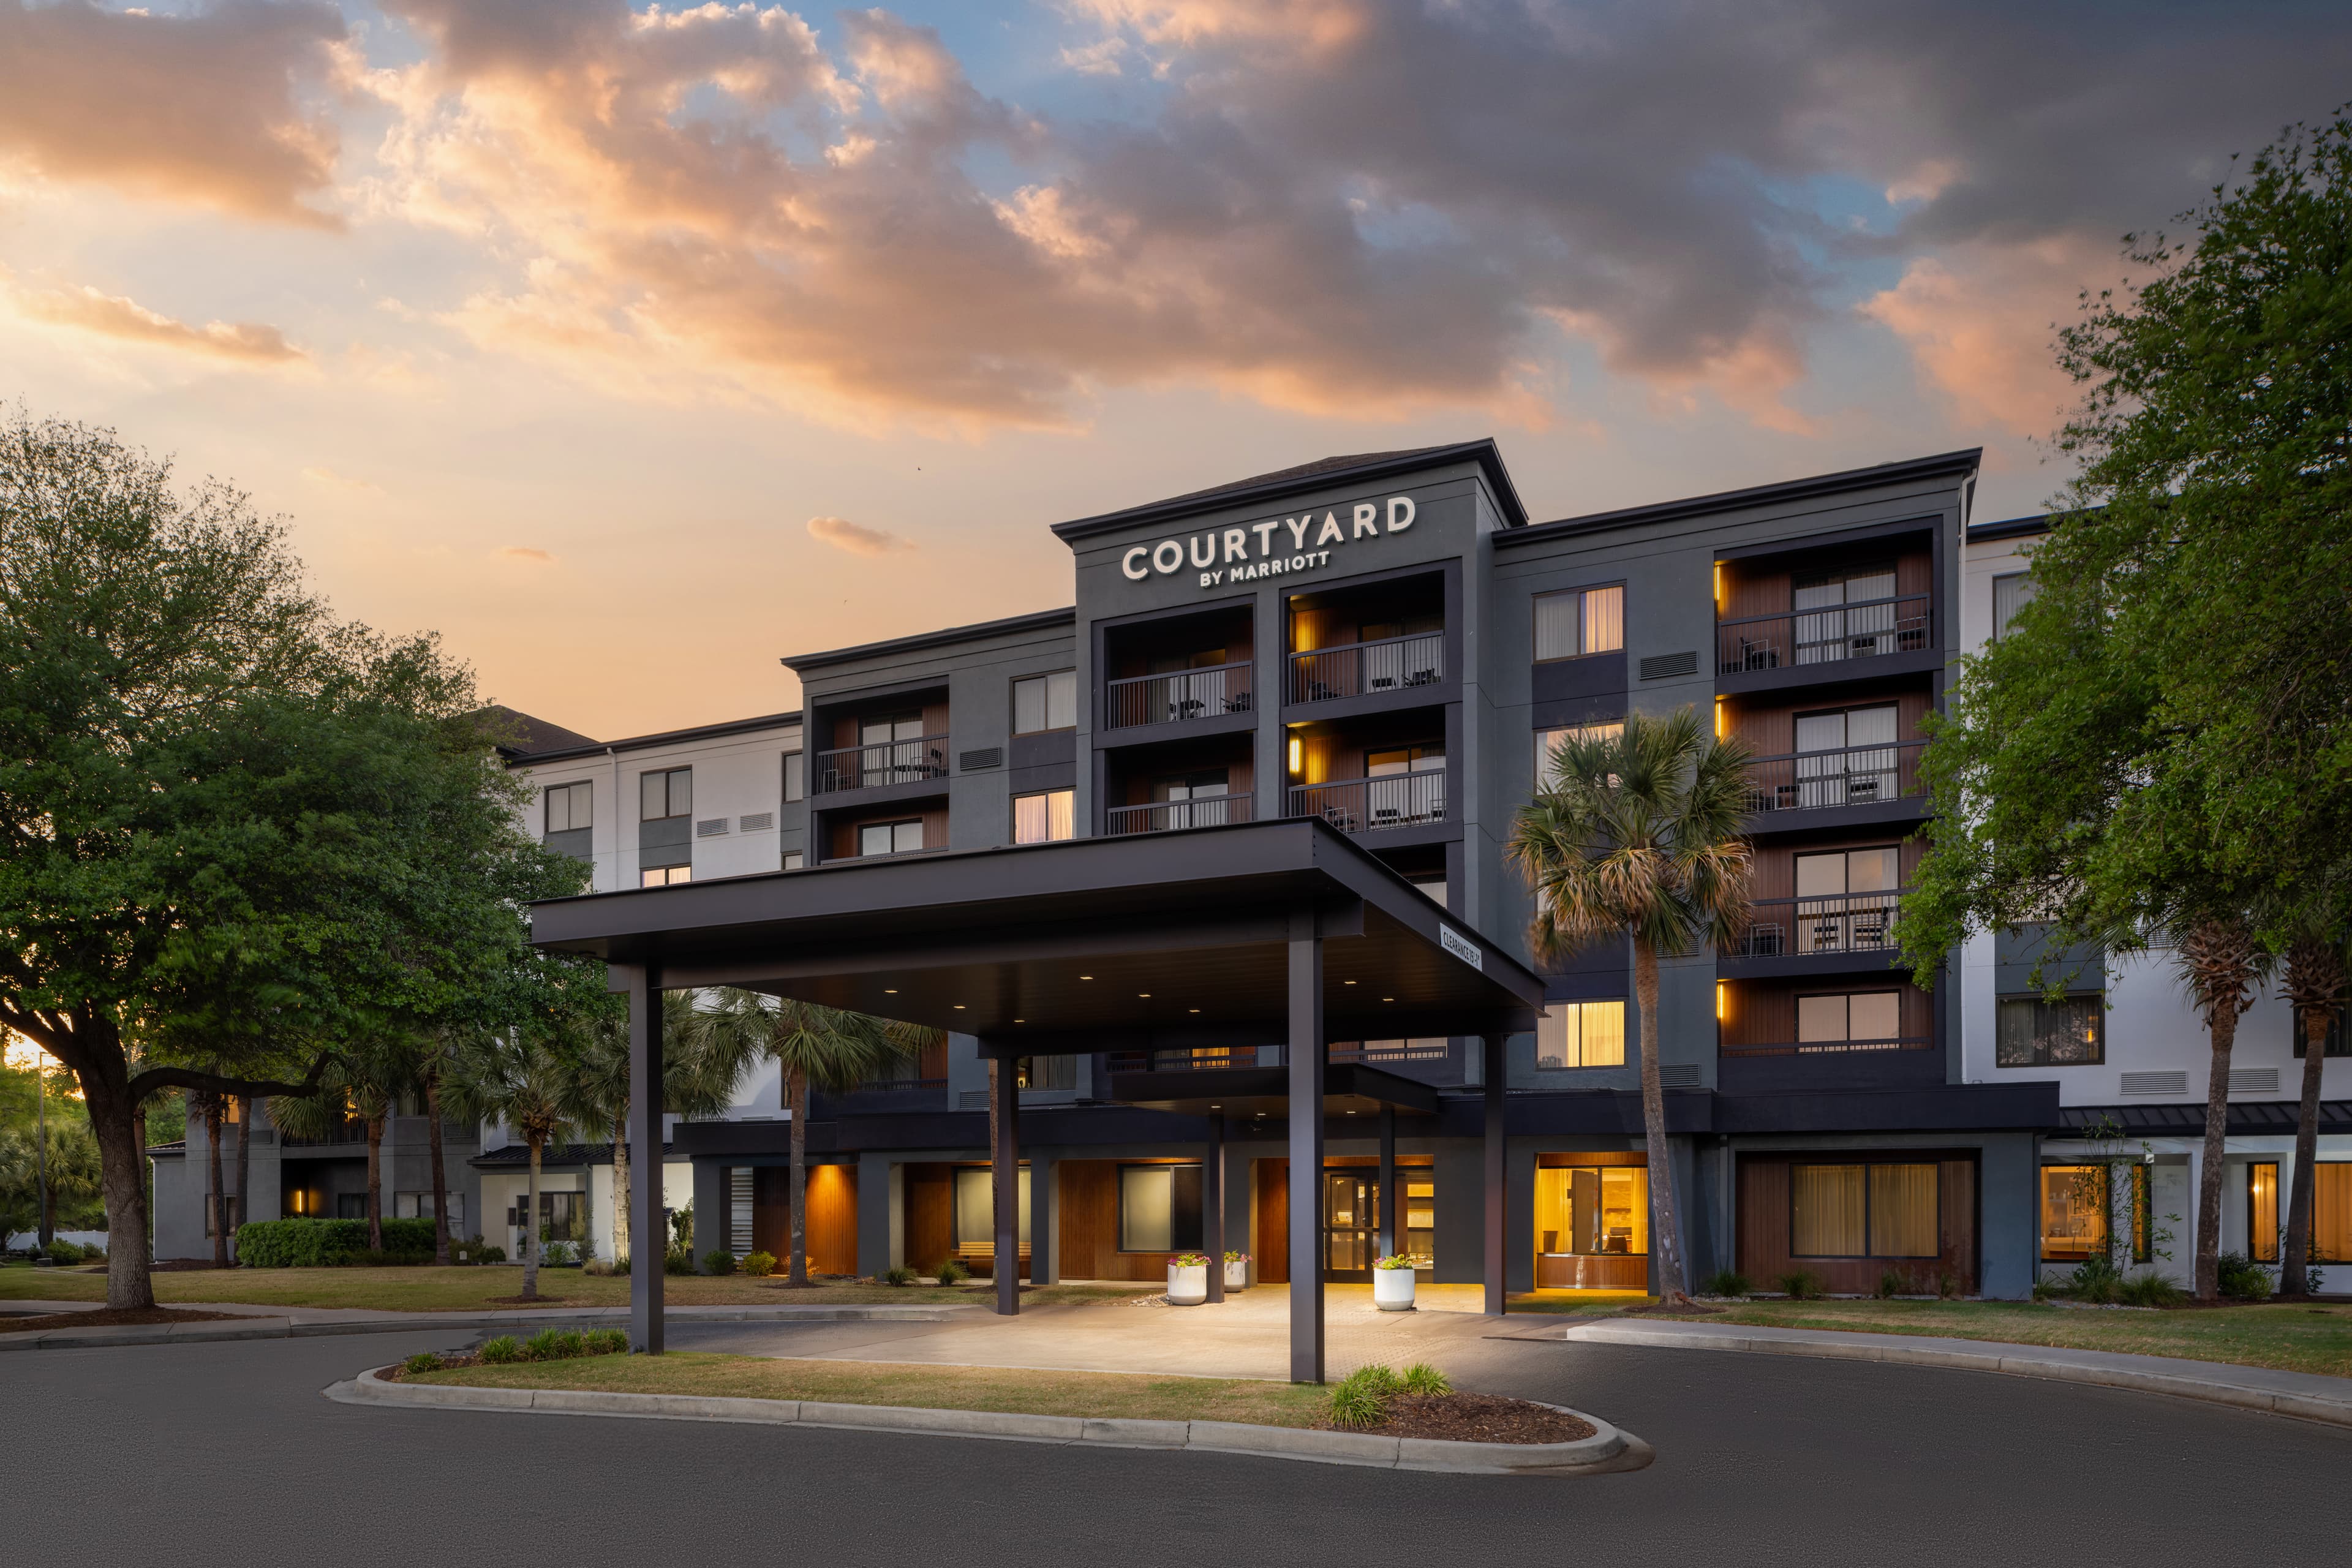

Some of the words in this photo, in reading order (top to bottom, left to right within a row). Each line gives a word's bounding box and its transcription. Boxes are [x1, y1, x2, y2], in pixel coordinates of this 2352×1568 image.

[1122, 496, 1416, 581] COURTYARD
[1199, 571, 1224, 589] BY
[1230, 551, 1330, 584] MARRIOTT
[1443, 931, 1469, 960] CLEARANCE
